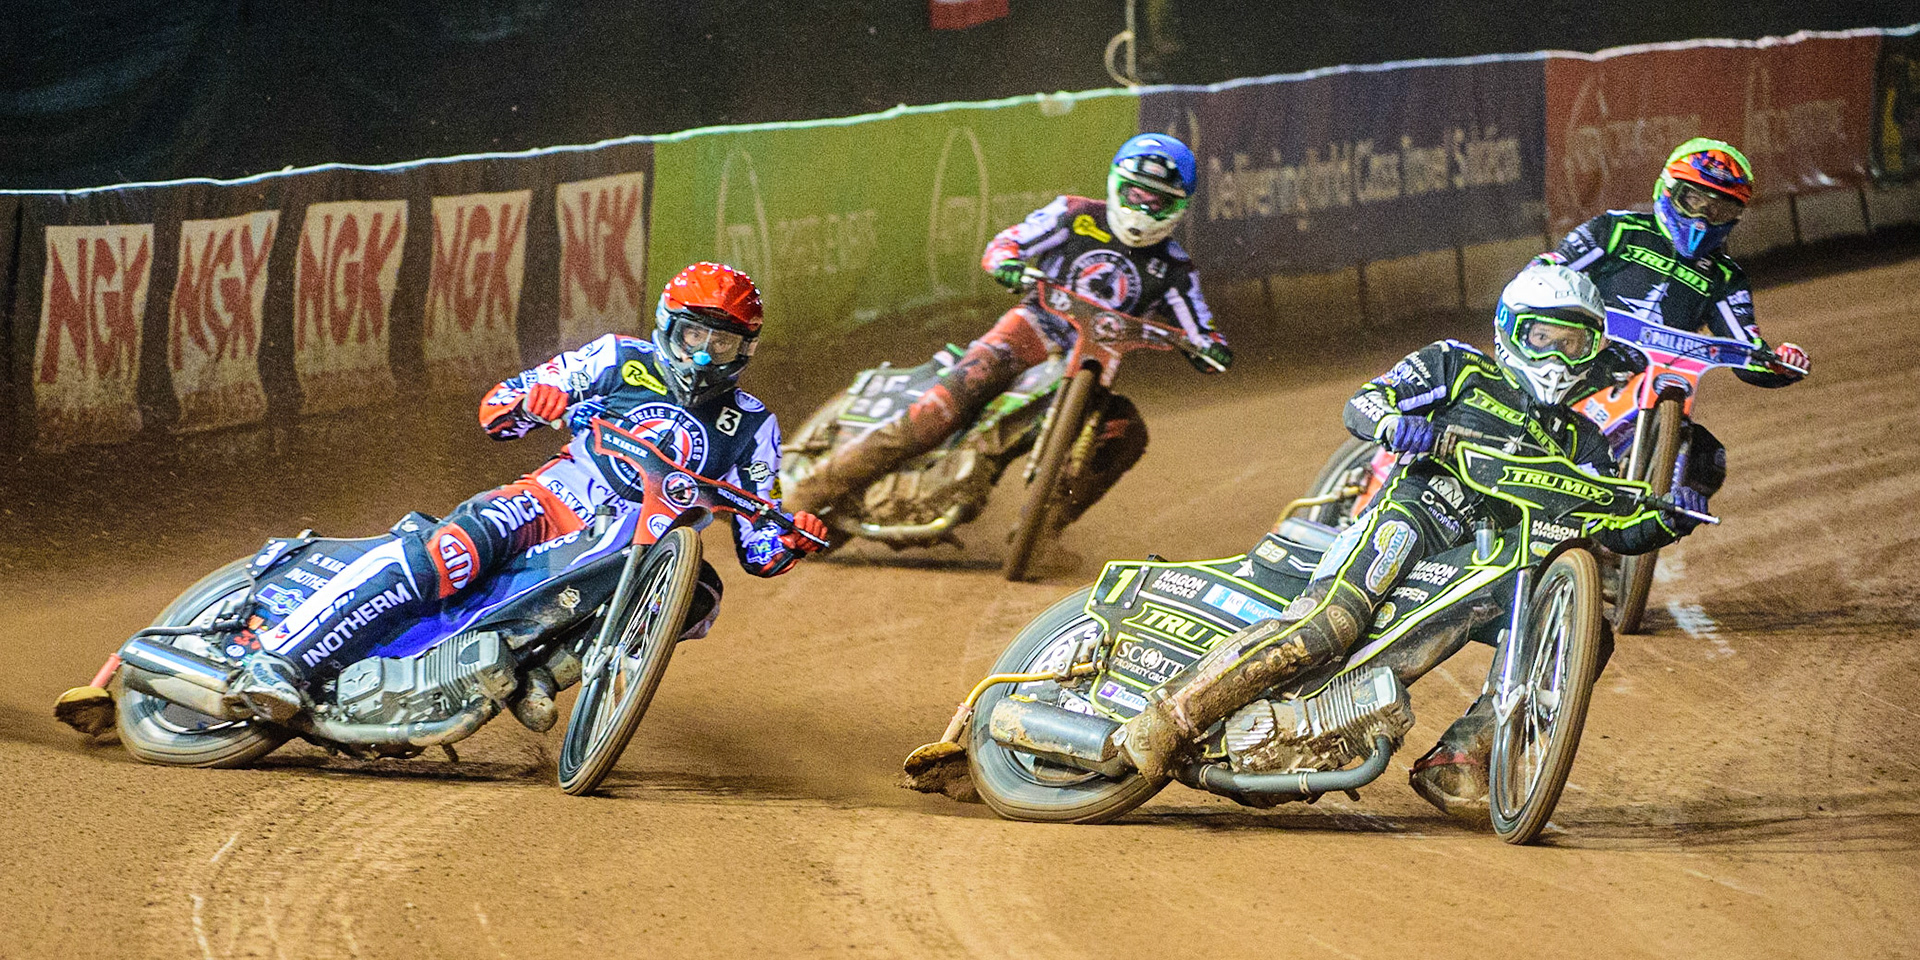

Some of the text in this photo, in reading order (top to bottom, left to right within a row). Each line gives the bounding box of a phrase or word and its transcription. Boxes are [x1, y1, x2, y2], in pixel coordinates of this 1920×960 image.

[562, 186, 637, 322] NGK
[1633, 249, 1674, 273] TRU
[299, 212, 402, 352] NGK
[426, 204, 526, 342] NGK
[40, 234, 149, 384] NGK
[173, 217, 274, 373] NGK
[629, 408, 665, 424] BELLE
[690, 430, 703, 461] ACES
[720, 409, 739, 432] 3
[1480, 396, 1561, 457] TRU MIX
[1552, 417, 1563, 433] 1
[717, 487, 757, 513] INOTHERM
[1511, 470, 1608, 500] TRU MIX
[1531, 519, 1580, 539] HAGON
[1372, 527, 1408, 586] AGROMIX
[1104, 568, 1140, 604] 1
[1151, 580, 1200, 600] SHOCKS
[1158, 569, 1208, 592] HAGON
[301, 582, 413, 668] INOTHERM
[1142, 609, 1209, 643] TRU
[1112, 657, 1150, 680] PROPERTY
[1117, 640, 1186, 677] SCOTT
